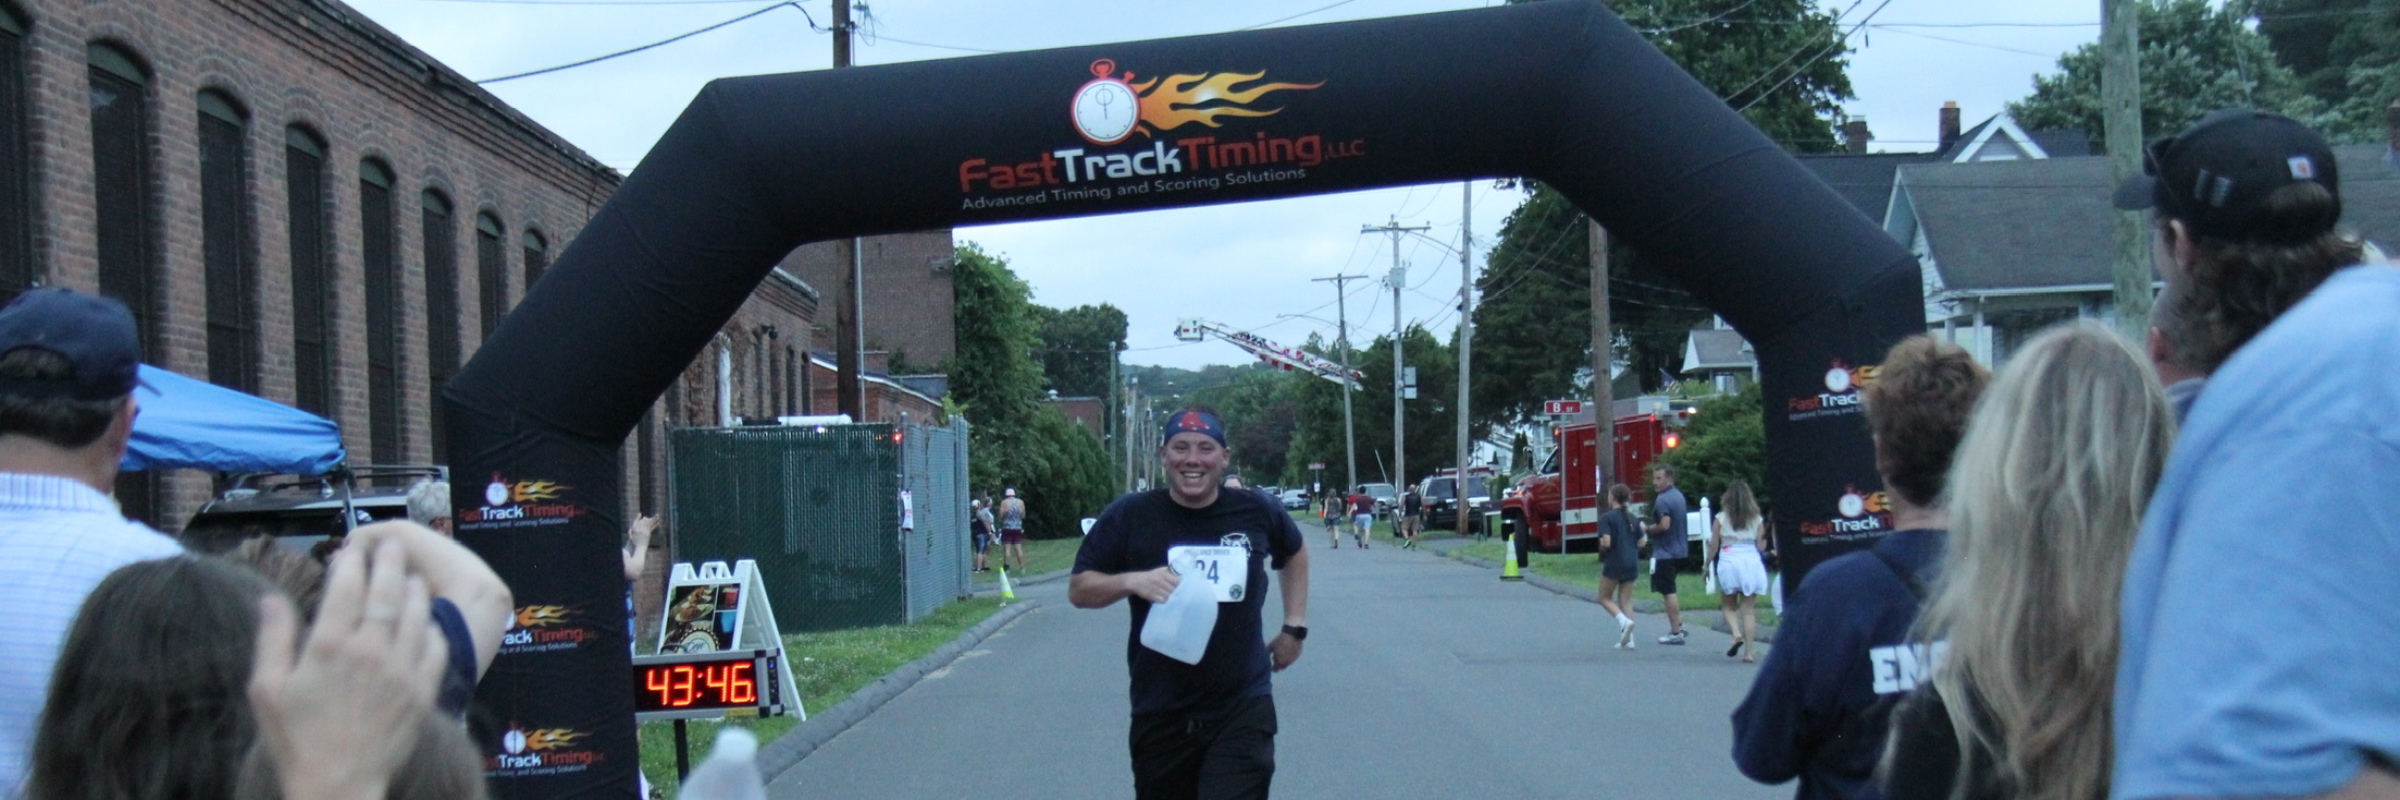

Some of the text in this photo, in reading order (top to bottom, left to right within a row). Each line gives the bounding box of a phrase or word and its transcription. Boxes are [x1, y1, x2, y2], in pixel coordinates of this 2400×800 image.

[962, 169, 1306, 210] Advanced Timing and Scoring Solutions
[1553, 402, 1561, 413] B
[539, 517, 569, 526] Solutions
[547, 641, 578, 651] Solutions
[556, 764, 588, 773] Solutions
